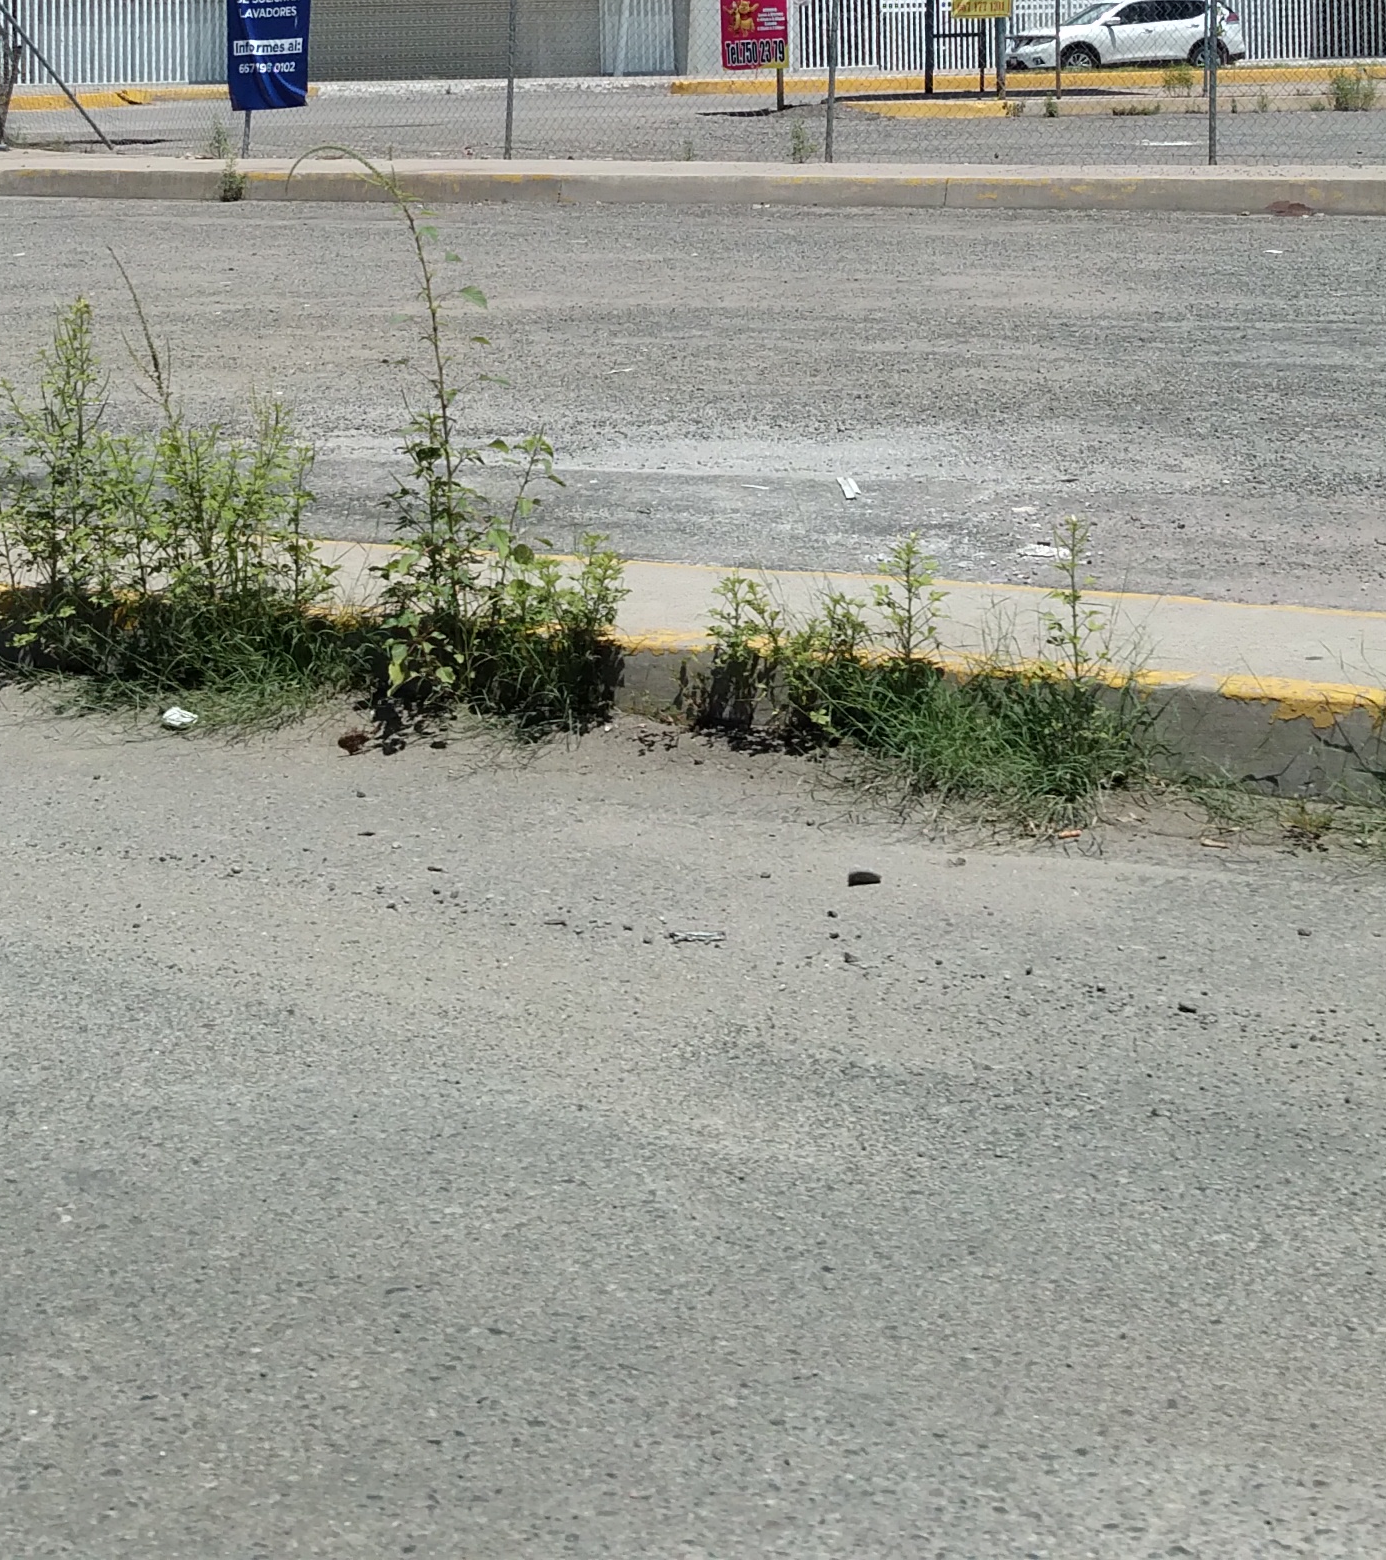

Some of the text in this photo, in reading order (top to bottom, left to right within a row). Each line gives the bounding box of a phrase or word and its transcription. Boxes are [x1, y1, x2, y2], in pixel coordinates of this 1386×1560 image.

[239, 6, 298, 19] LAVADORES
[235, 42, 285, 54] Informes
[759, 40, 772, 63] 23
